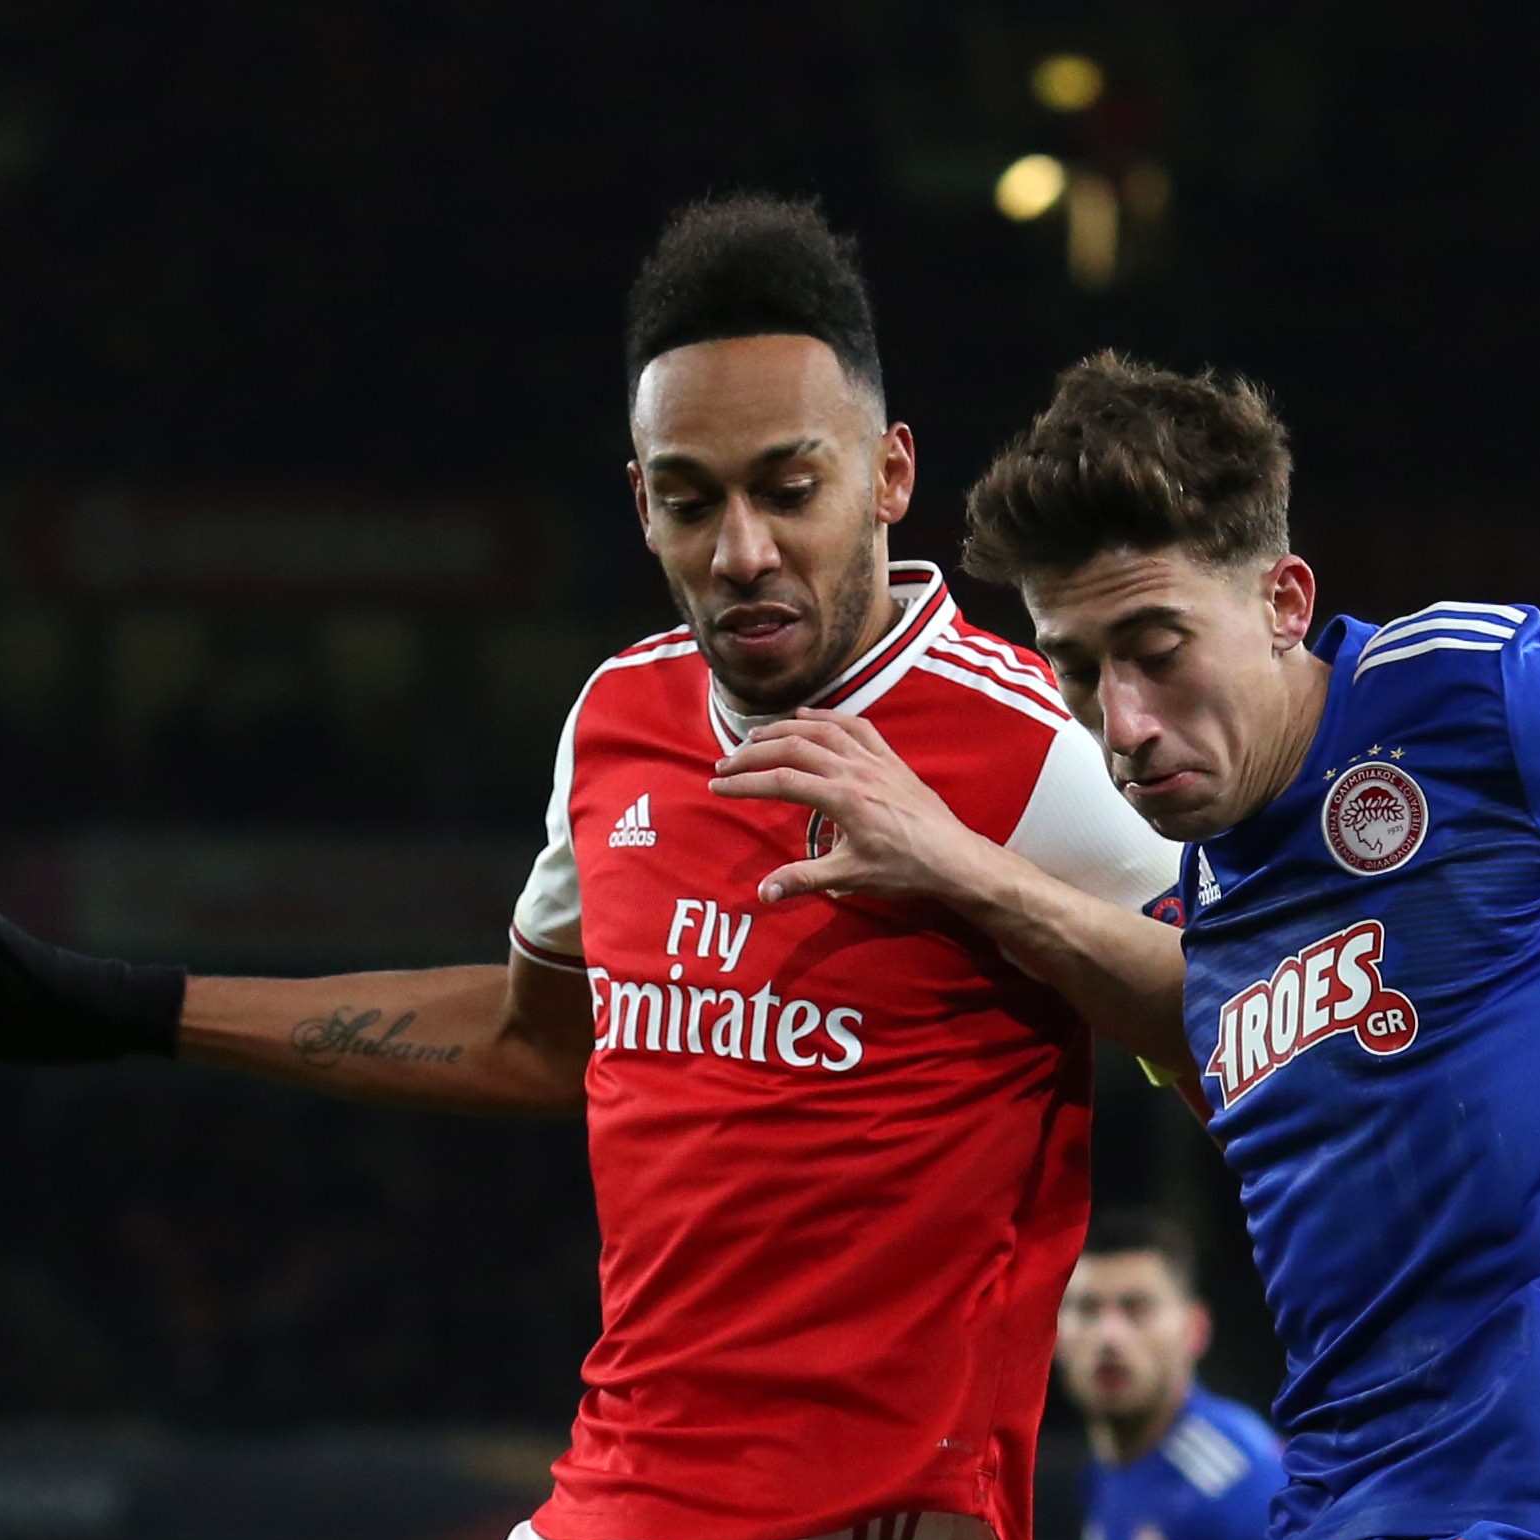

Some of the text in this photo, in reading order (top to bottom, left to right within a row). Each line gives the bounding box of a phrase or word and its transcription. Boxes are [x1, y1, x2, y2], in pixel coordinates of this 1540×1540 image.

[608, 827, 657, 848] adidas
[667, 898, 753, 973] Fly
[587, 963, 864, 1072] Emirates
[1216, 931, 1407, 1093] IROES GR
